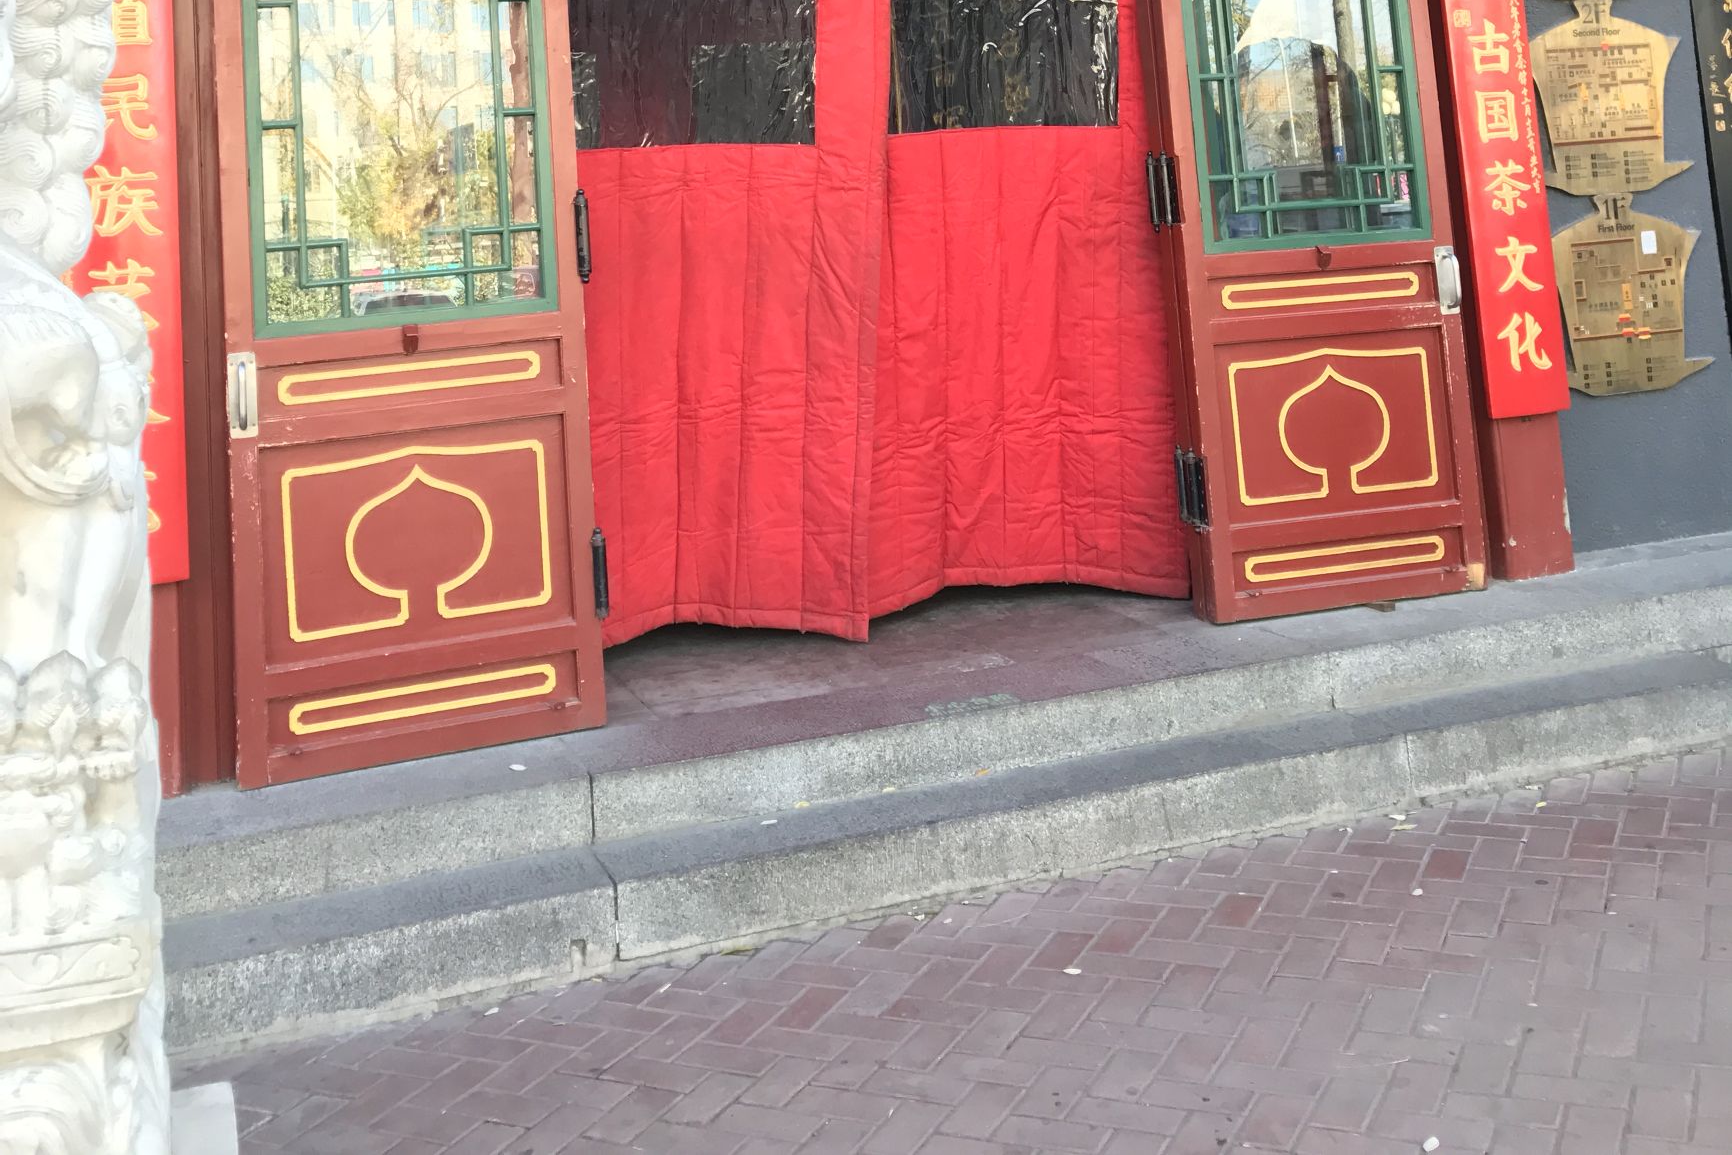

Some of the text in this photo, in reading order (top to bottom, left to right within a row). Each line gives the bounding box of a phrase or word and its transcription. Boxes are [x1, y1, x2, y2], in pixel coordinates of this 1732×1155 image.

[1582, 3, 1607, 25] 2F
[1572, 27, 1621, 38] Second Floor
[1602, 196, 1626, 220] 1F
[1598, 223, 1635, 233] First Floor
